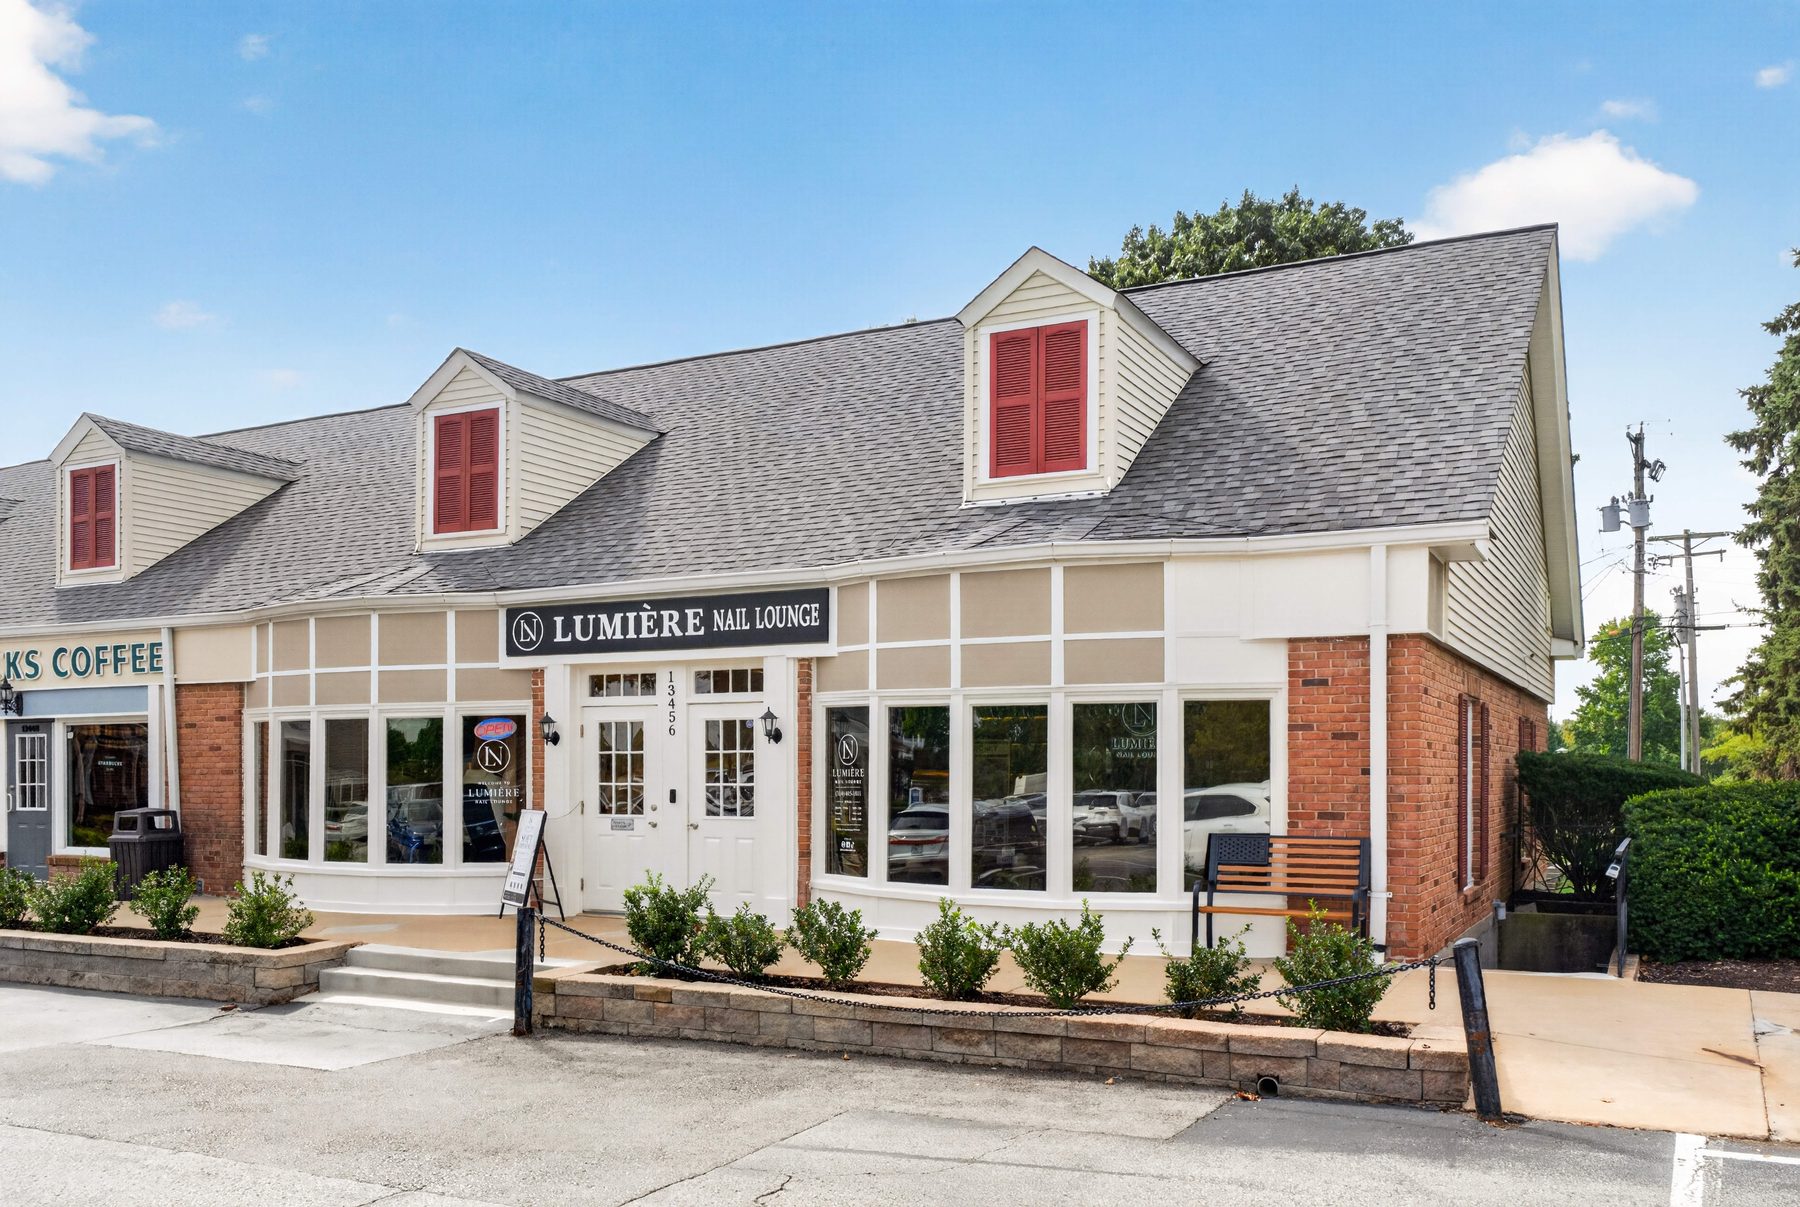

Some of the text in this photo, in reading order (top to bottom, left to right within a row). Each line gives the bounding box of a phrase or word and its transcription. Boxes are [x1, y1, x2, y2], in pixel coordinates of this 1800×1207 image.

[553, 603, 705, 643] LUMIÈRE
[712, 608, 750, 632] NAIL
[755, 603, 820, 629] LOUNGE
[52, 641, 163, 679] COFFEE
[667, 670, 676, 736] 13456
[476, 721, 513, 736] OPEN
[832, 766, 865, 778] LUMIÈRE
[468, 786, 520, 798] LUMIÈRE
